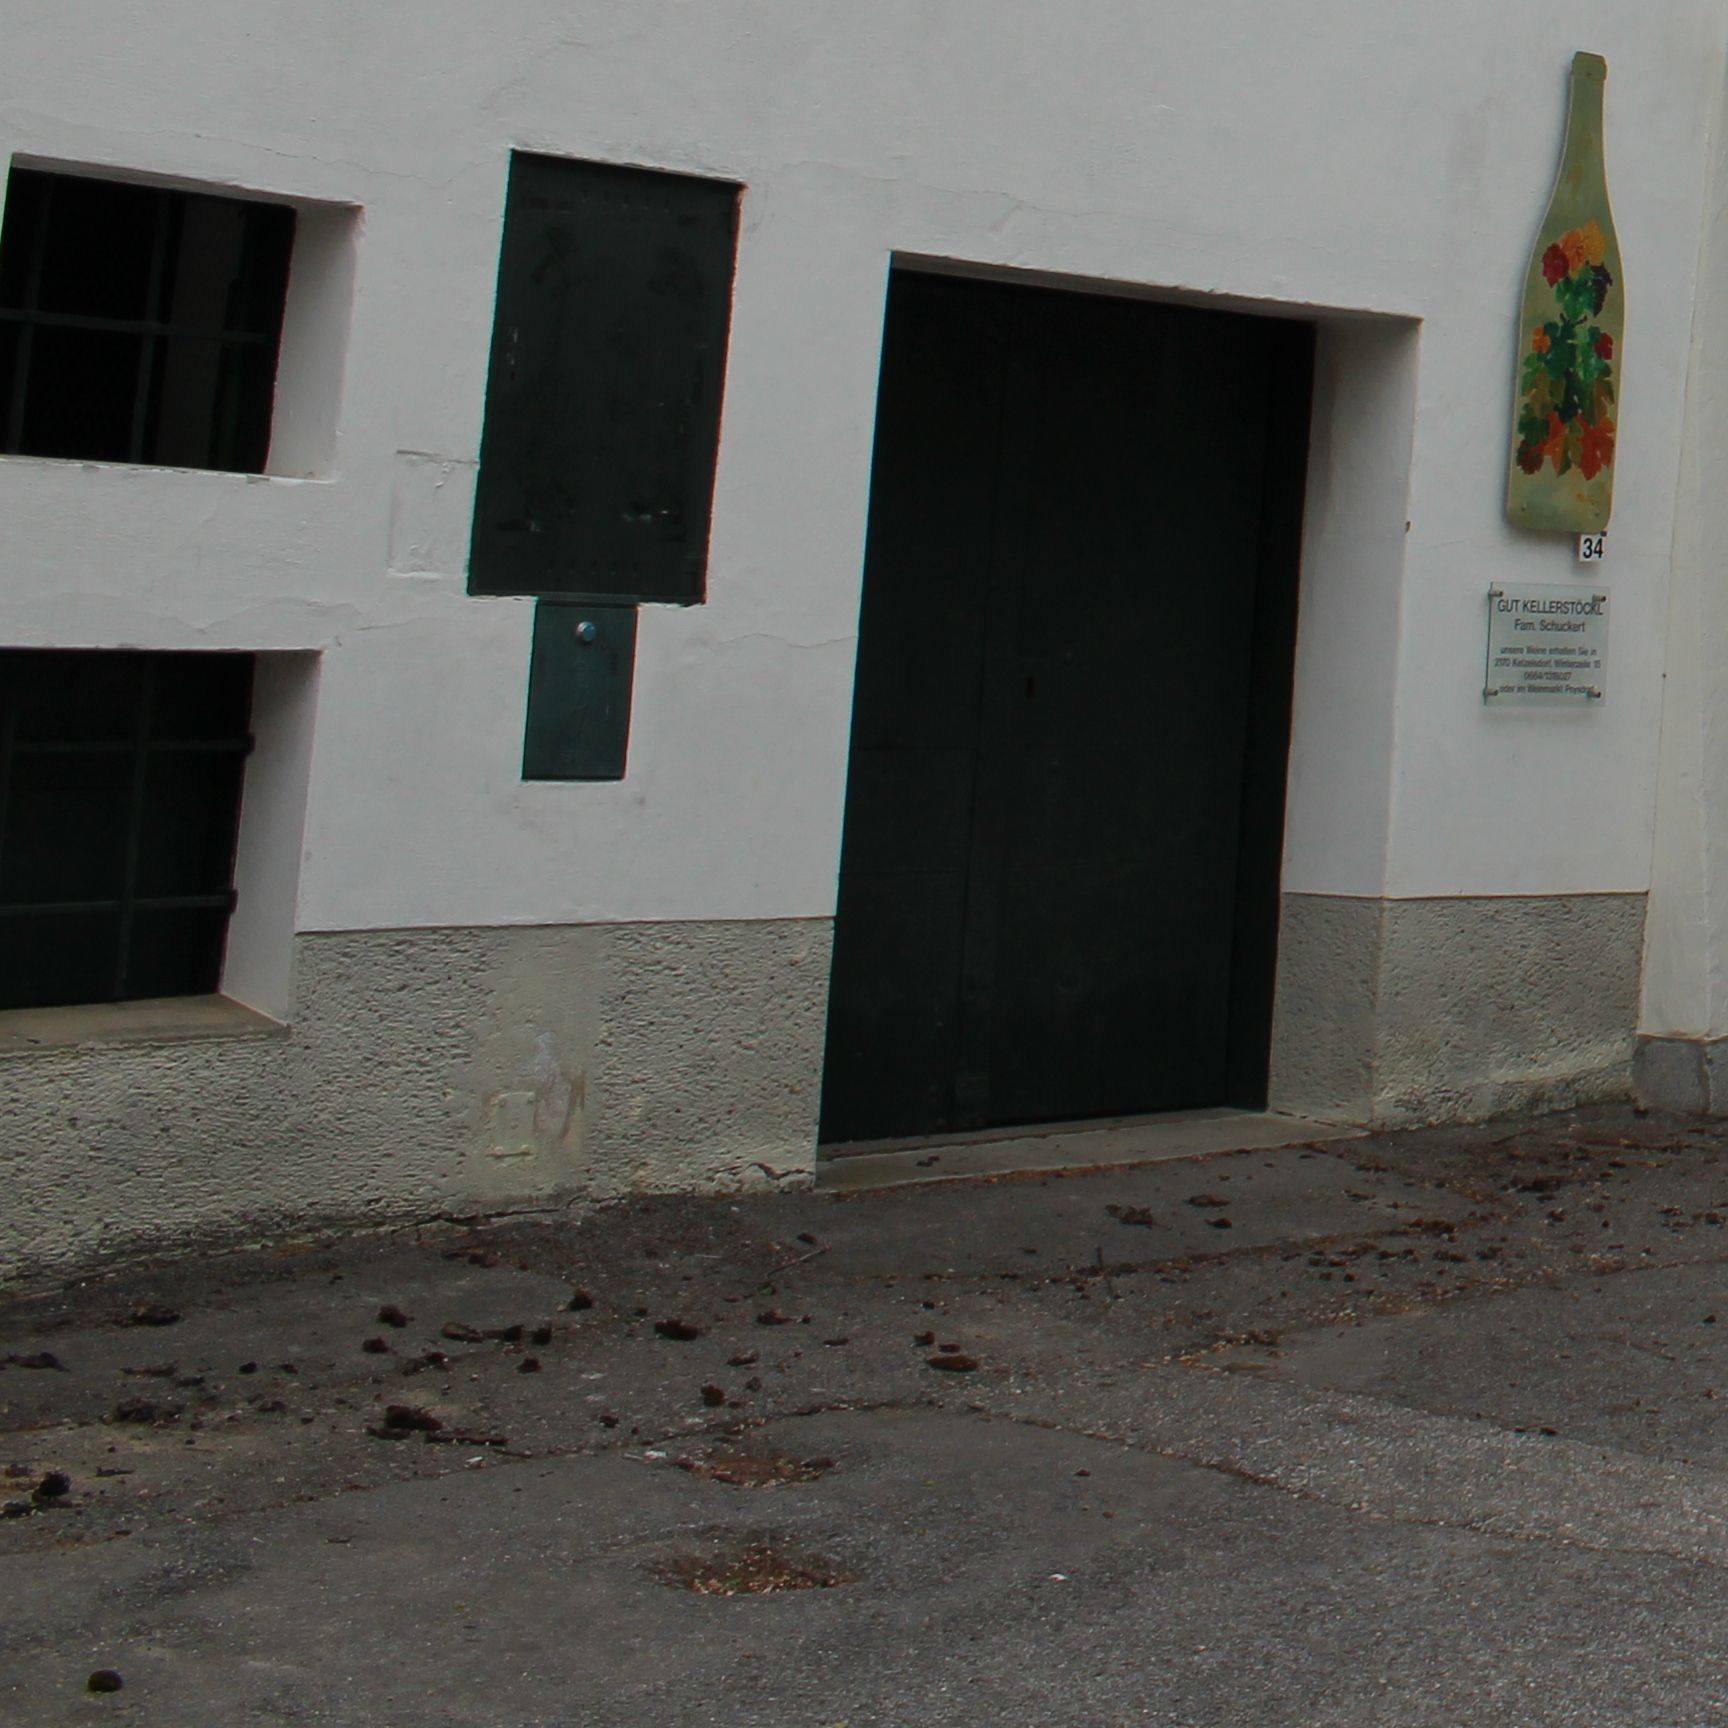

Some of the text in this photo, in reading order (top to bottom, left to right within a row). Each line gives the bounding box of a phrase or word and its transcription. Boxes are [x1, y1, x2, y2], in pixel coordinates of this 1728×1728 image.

[1582, 537, 1603, 559] 34
[1498, 599, 1603, 615] GUT KELLERSTÖCKL
[1514, 618, 1586, 632] Fam. Schuckert
